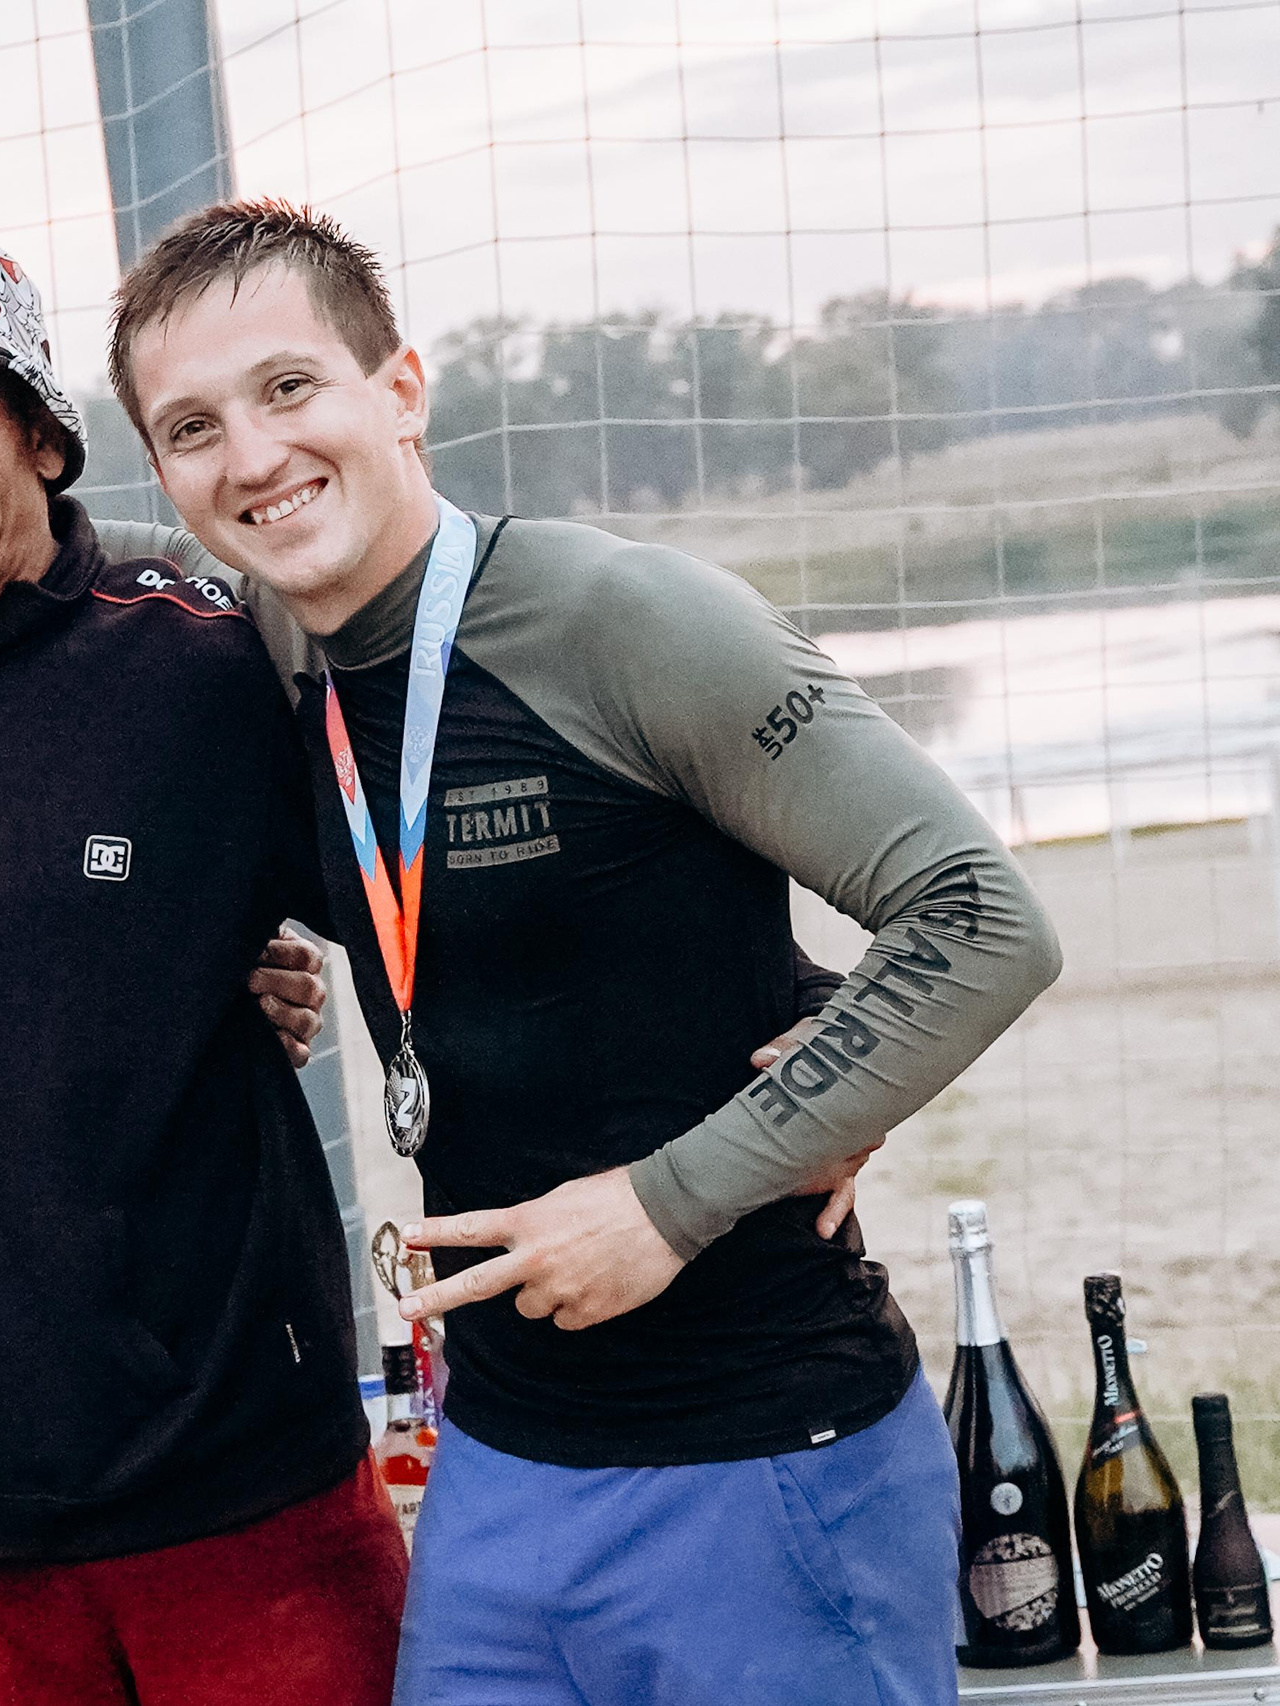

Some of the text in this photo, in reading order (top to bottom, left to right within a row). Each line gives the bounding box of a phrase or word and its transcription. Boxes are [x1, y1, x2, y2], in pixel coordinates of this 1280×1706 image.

[185, 576, 245, 611] HOE
[413, 544, 467, 677] RUSSIA
[766, 683, 826, 744] 50+
[491, 779, 545, 797] 1989
[445, 800, 551, 843] TERMIT
[90, 842, 126, 874] DC
[448, 838, 557, 866] BORN TO RIDE
[853, 926, 952, 1017] ALL
[748, 1009, 881, 1128] RIDE
[397, 1076, 417, 1130] 2
